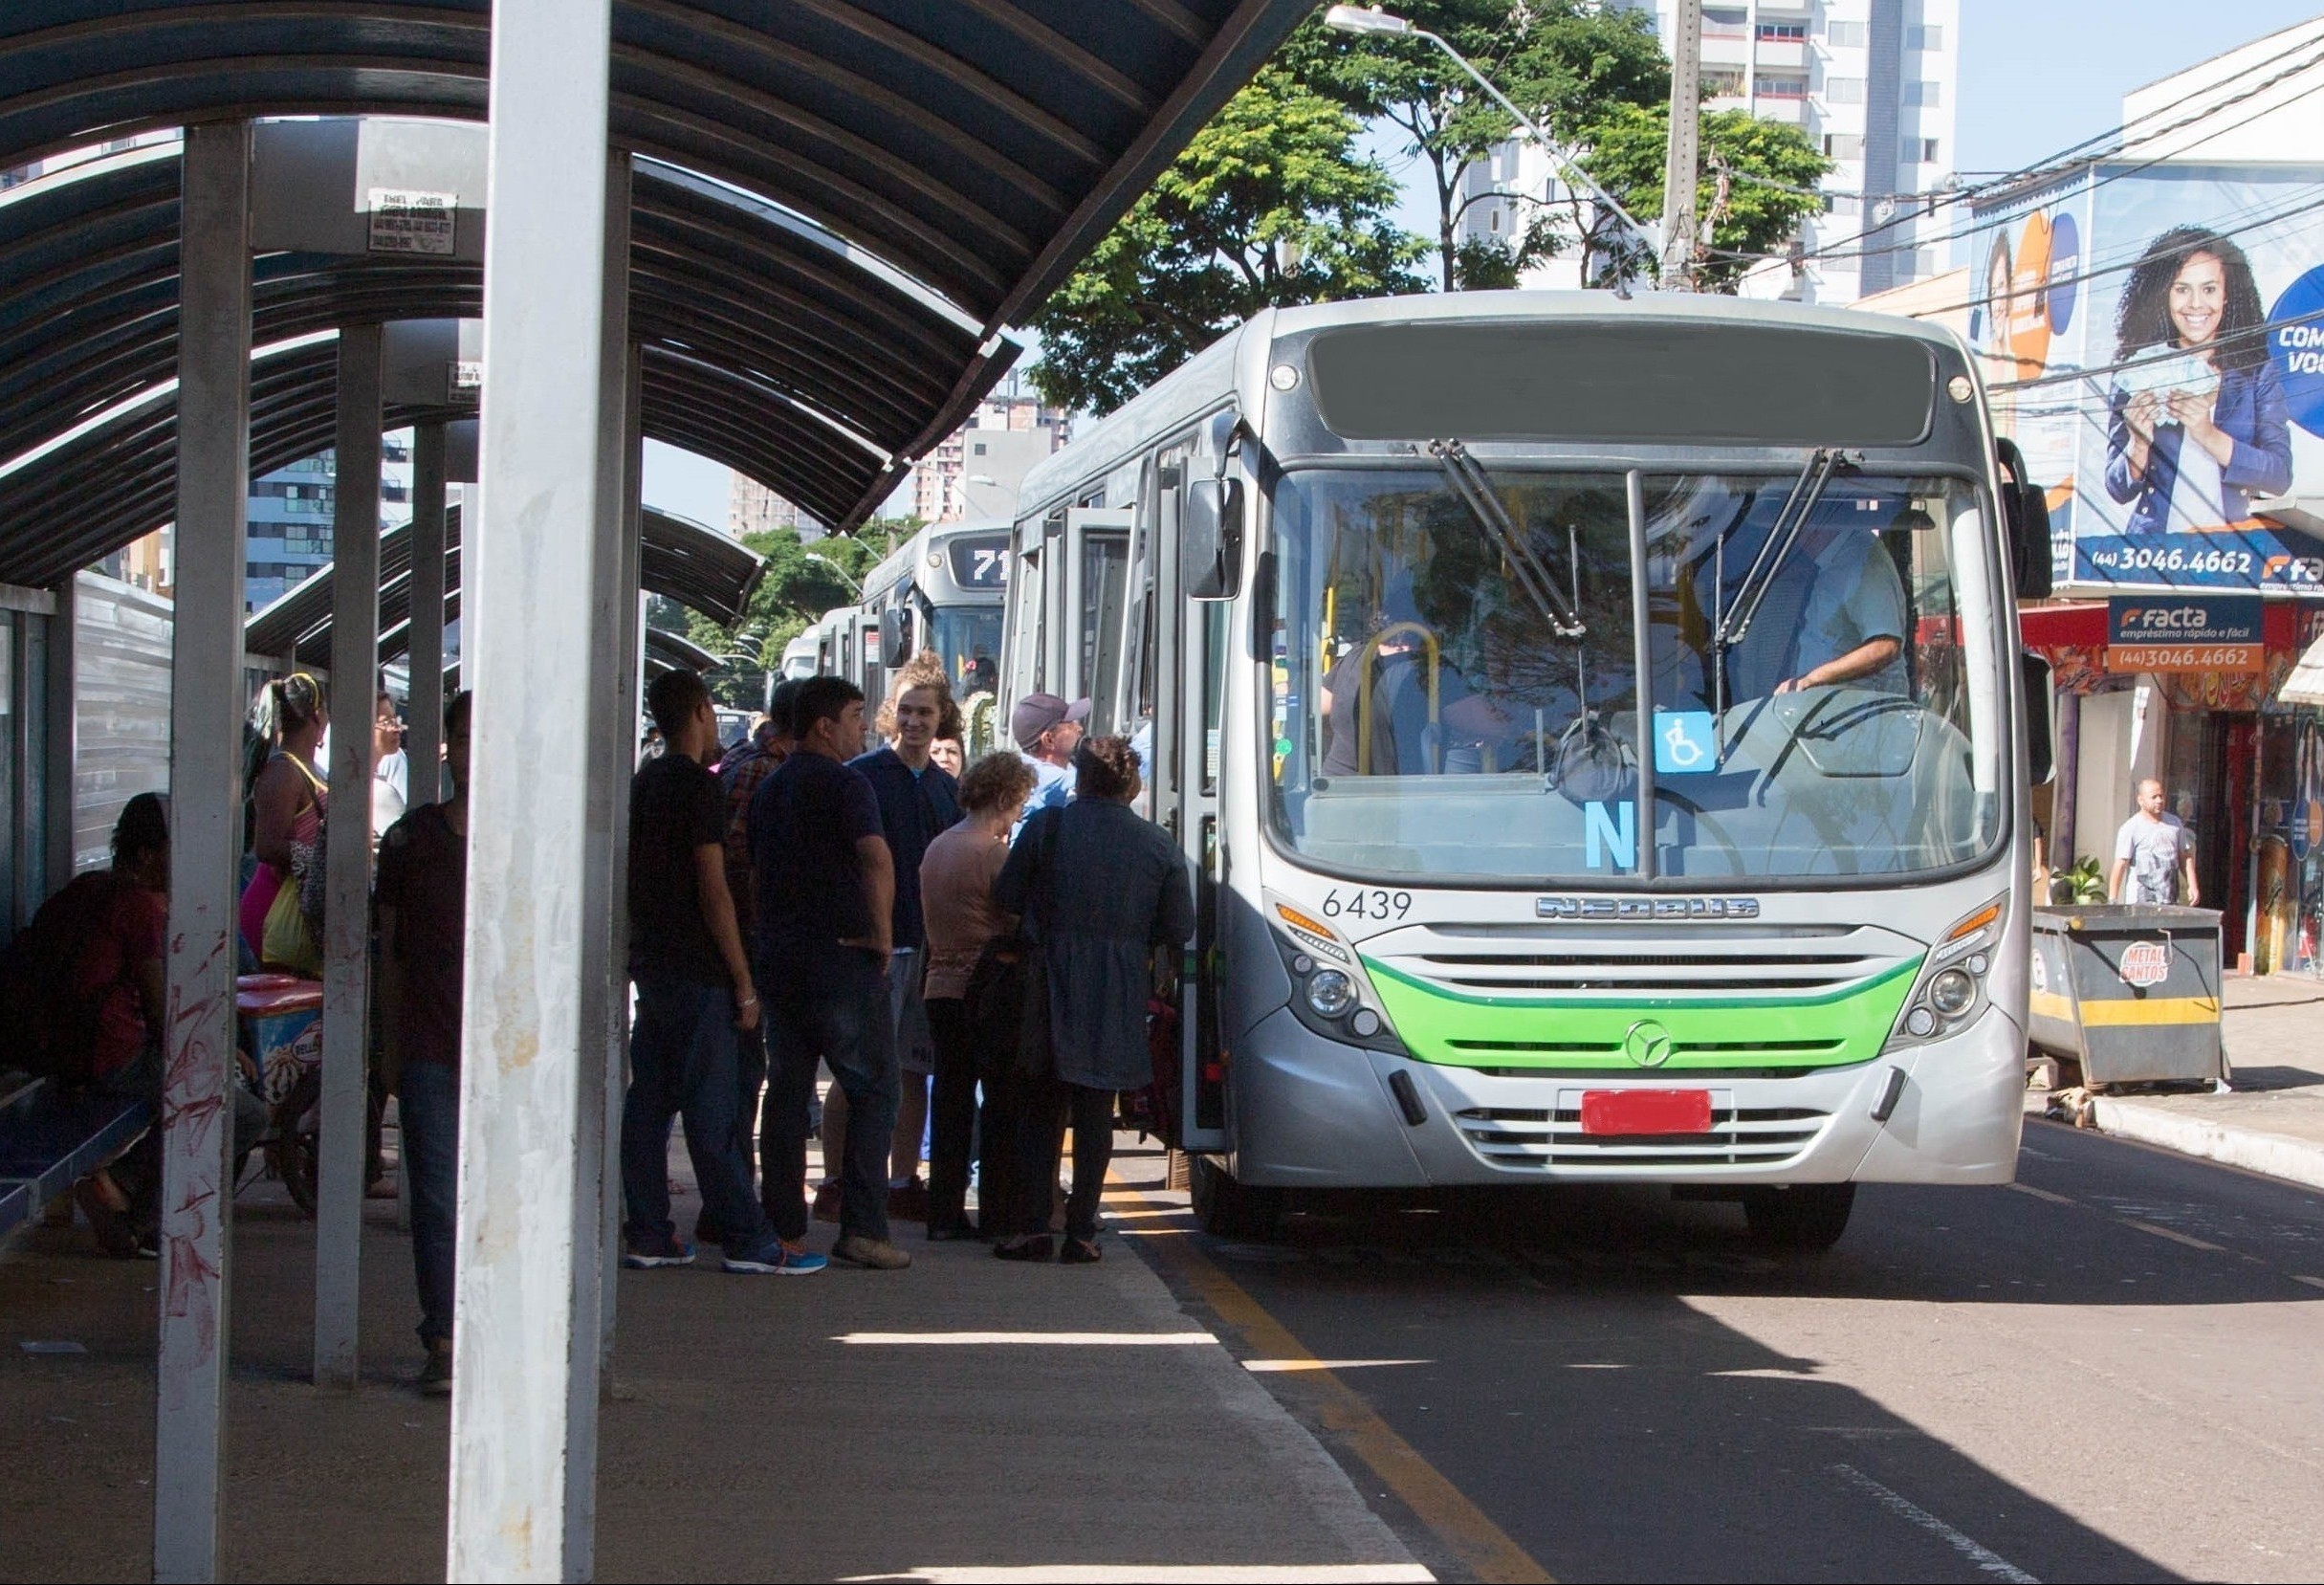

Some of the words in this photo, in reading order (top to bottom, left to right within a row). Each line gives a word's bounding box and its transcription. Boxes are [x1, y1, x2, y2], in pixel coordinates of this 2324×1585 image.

[2119, 547, 2251, 573] 3046.4662
[2142, 605, 2207, 627] facta
[2120, 627, 2181, 639] empréstimo
[2183, 627, 2217, 639] rápido
[2225, 627, 2249, 639] fácil
[1585, 801, 1634, 869] N
[1323, 889, 1413, 920] 6439
[1536, 897, 1760, 920] NEOBUS
[2127, 947, 2163, 963] METAL
[2121, 965, 2166, 981] SANTOS
